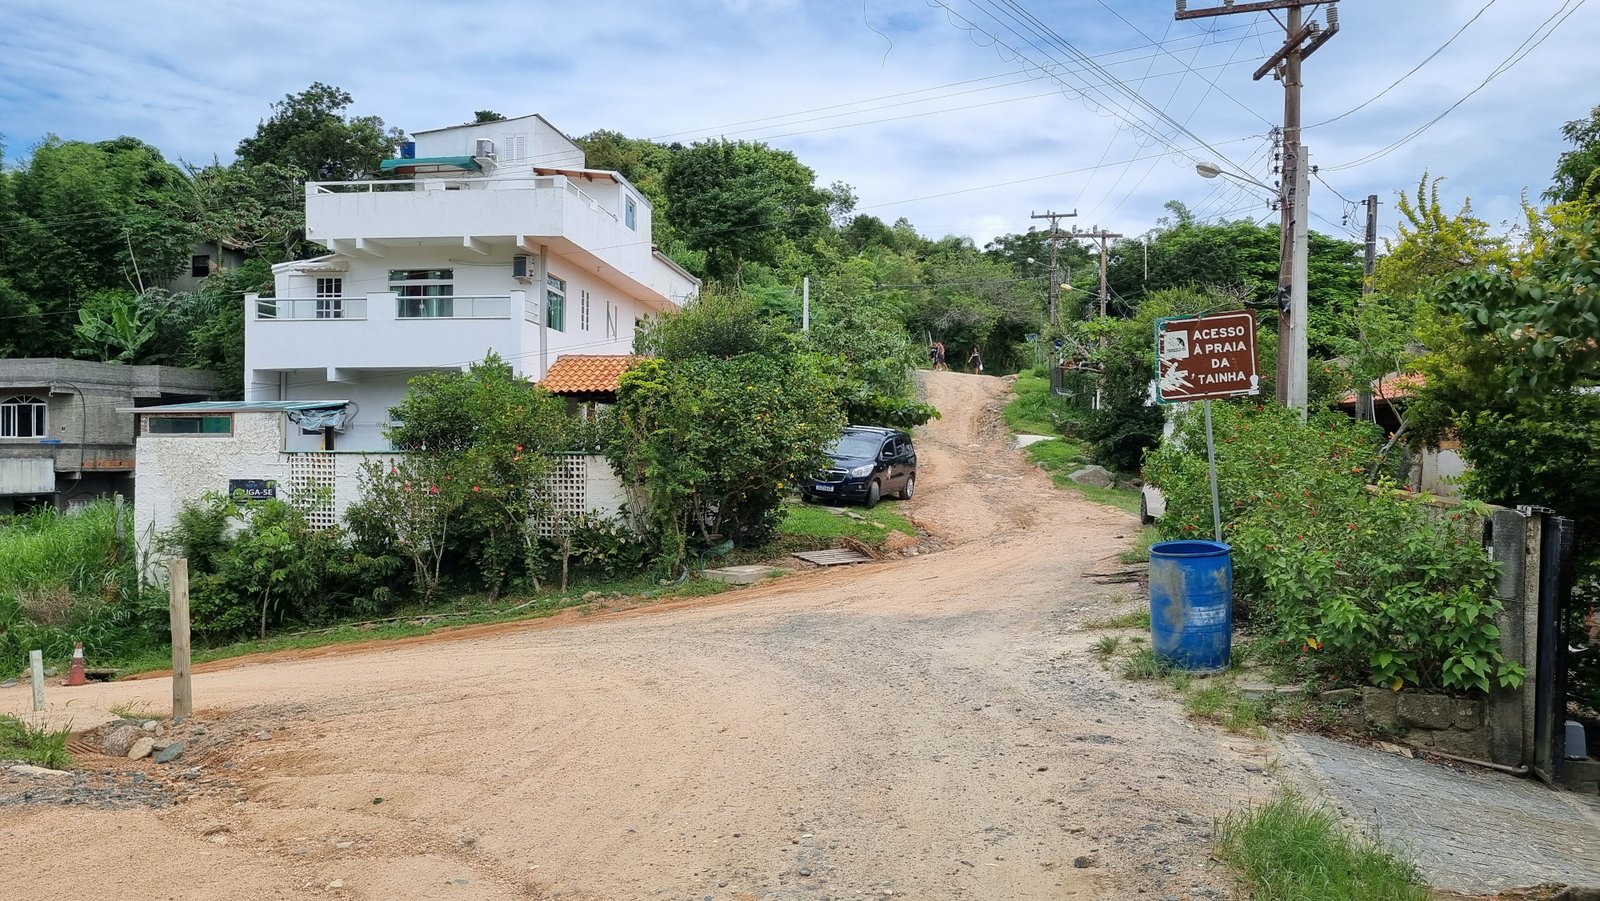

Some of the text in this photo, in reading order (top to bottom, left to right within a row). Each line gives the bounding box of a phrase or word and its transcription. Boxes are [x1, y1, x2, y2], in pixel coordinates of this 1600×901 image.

[1193, 326, 1245, 340] ACESSO
[1194, 343, 1202, 355] À
[1205, 341, 1247, 354] PRAIA
[1211, 358, 1230, 368] DA
[1198, 371, 1247, 385] TAINHA
